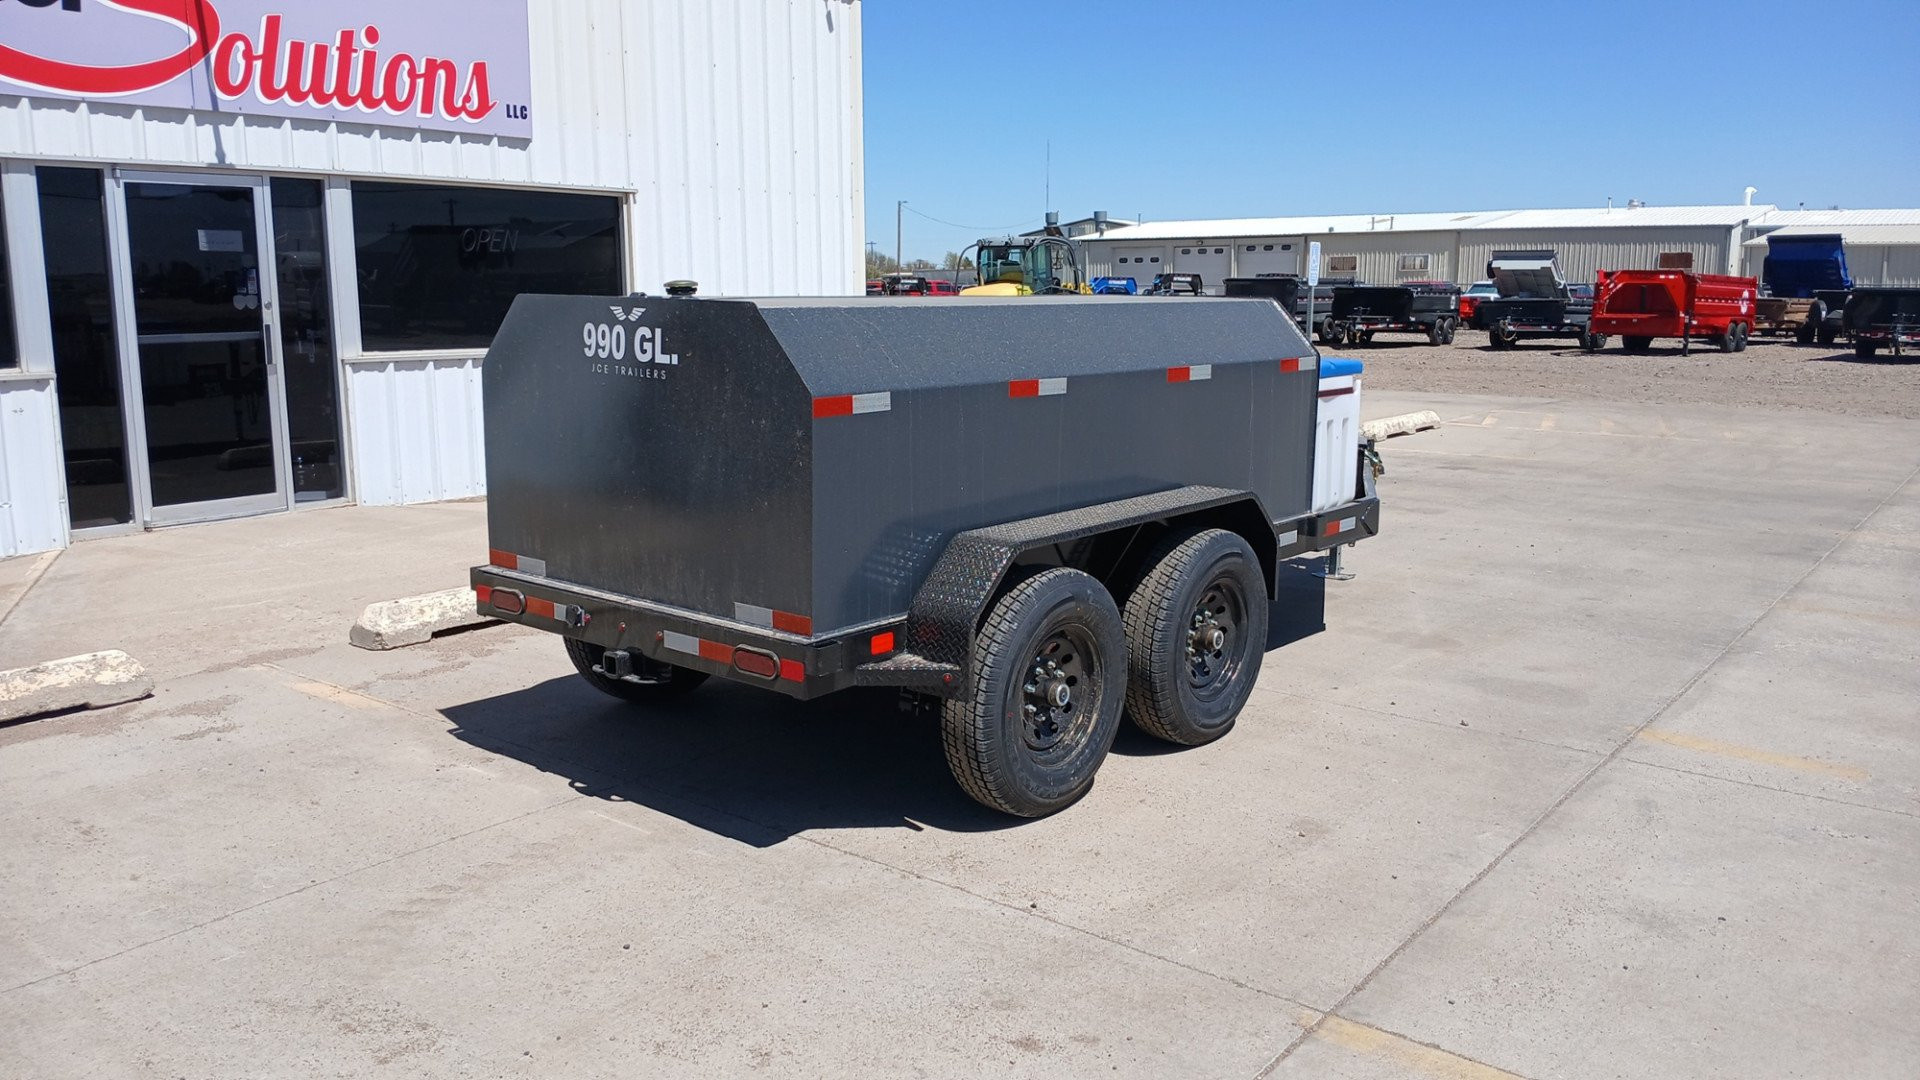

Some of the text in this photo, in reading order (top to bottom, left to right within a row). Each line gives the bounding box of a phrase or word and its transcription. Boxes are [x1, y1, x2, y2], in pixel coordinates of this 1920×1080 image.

[505, 103, 528, 120] LLC
[462, 228, 519, 252] OPEN
[583, 322, 678, 365] 990 GL.
[615, 365, 667, 380] TRAILERS
